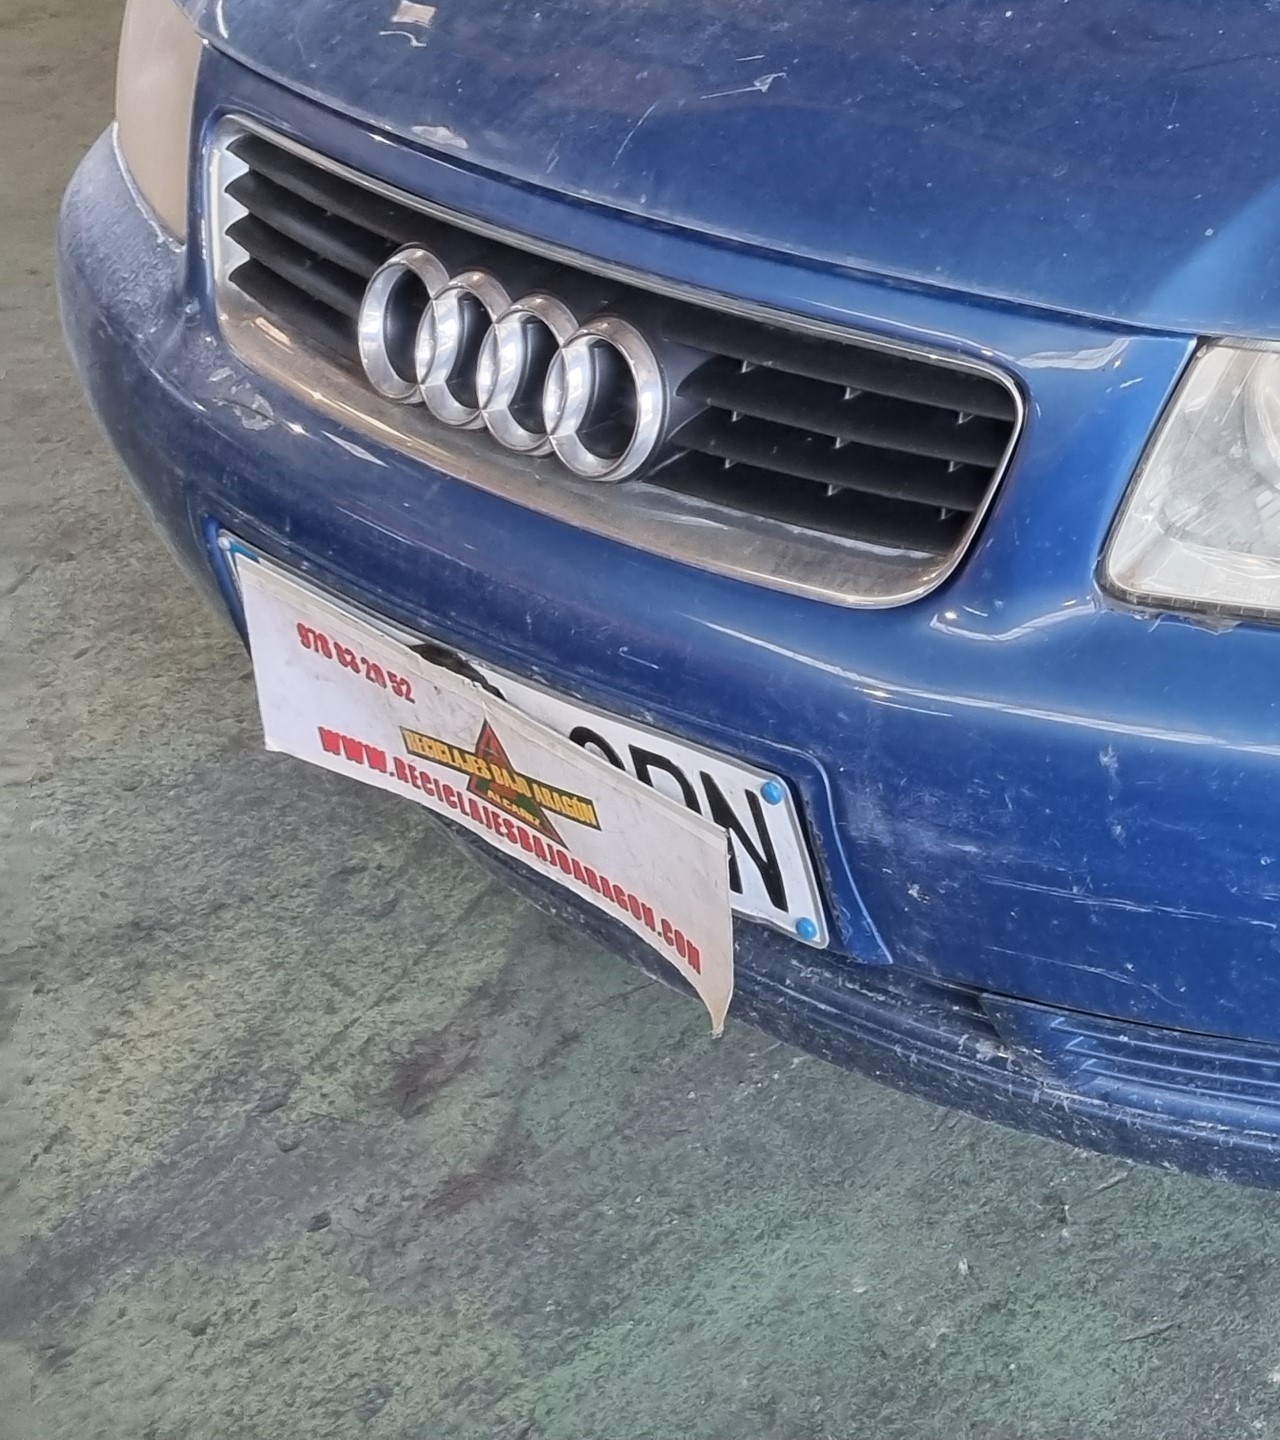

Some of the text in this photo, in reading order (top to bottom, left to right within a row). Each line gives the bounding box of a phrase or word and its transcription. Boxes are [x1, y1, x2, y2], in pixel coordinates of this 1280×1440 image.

[387, 670, 415, 704] 52
[406, 732, 597, 826] RECICLAJES BAJO ARAGÓN
[317, 726, 701, 974] WWW.RECICLAJESBAJOARAGON.COM
